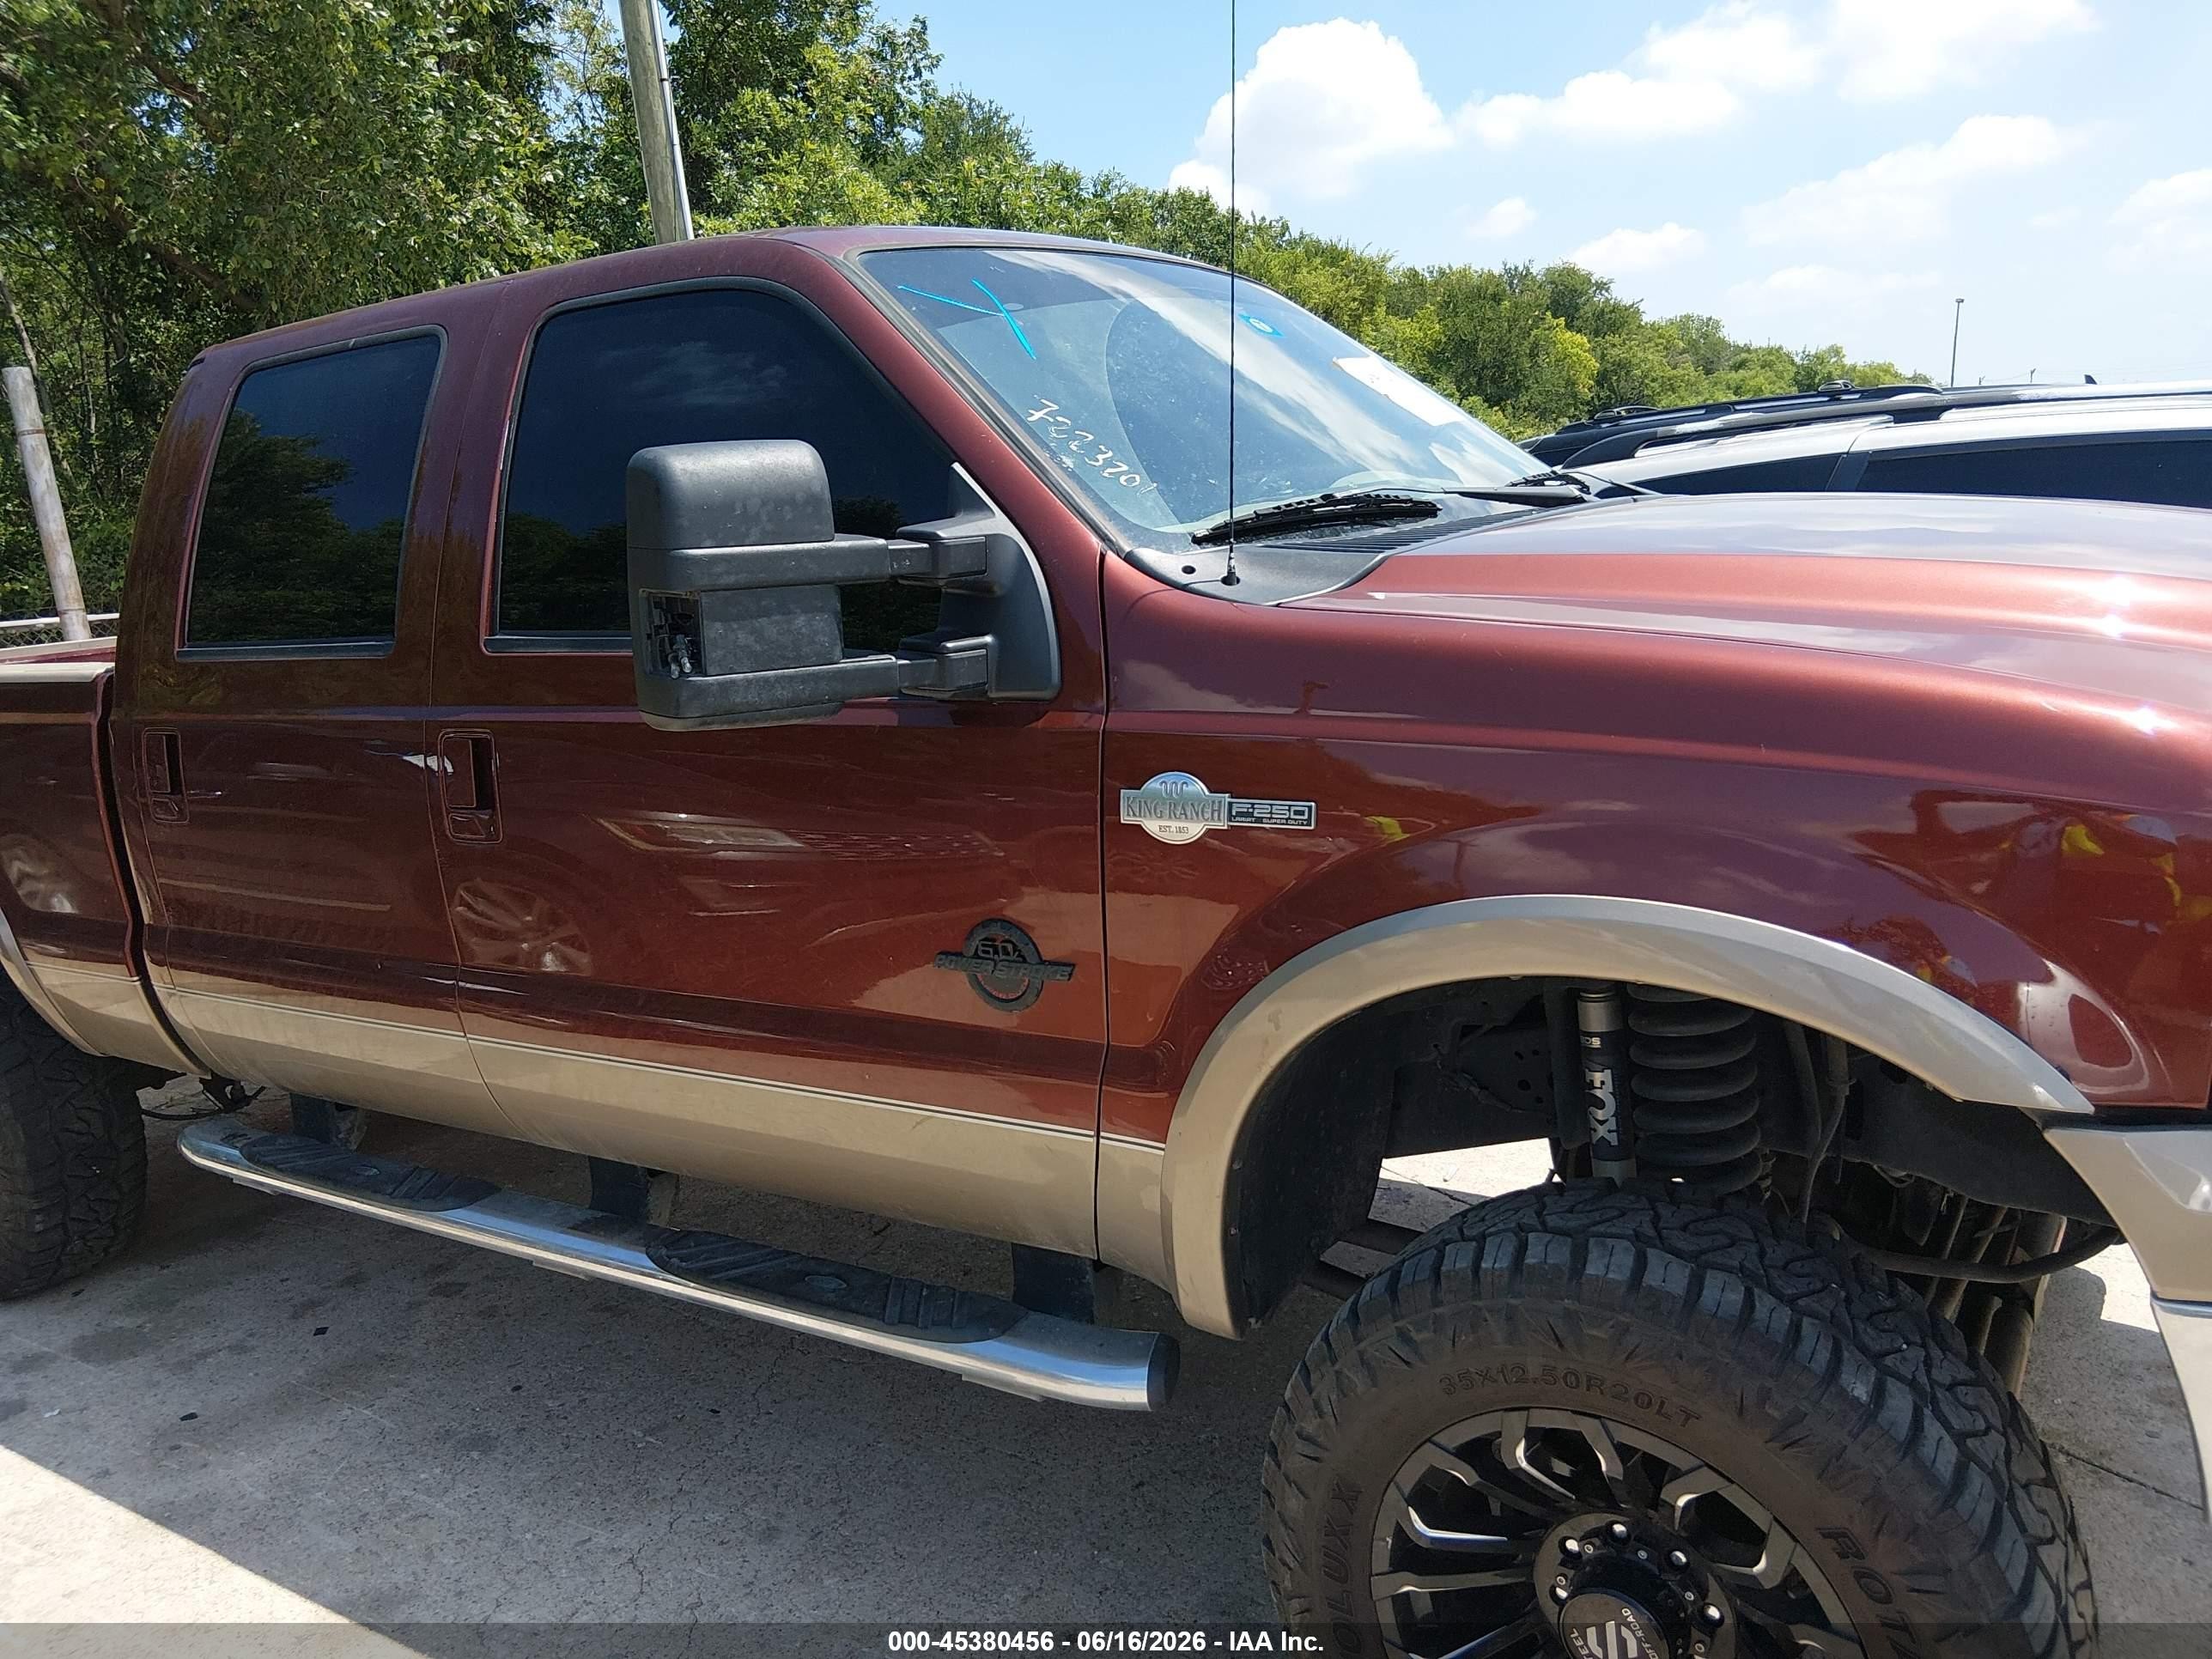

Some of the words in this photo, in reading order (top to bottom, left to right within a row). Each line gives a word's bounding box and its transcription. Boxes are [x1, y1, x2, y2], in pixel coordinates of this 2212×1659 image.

[1125, 796, 1164, 819] KING
[1168, 799, 1223, 822] RANCH
[1231, 803, 1309, 819] F-250
[1158, 825, 1174, 834] EST.
[1175, 826, 1189, 835] 1853
[935, 954, 994, 975] POWER
[994, 961, 1073, 981] STROKE
[1584, 1068, 1619, 1146] FOX
[1438, 1362, 1704, 1429] 35X12.50R20LT
[1320, 1478, 1364, 1659] OLUXX
